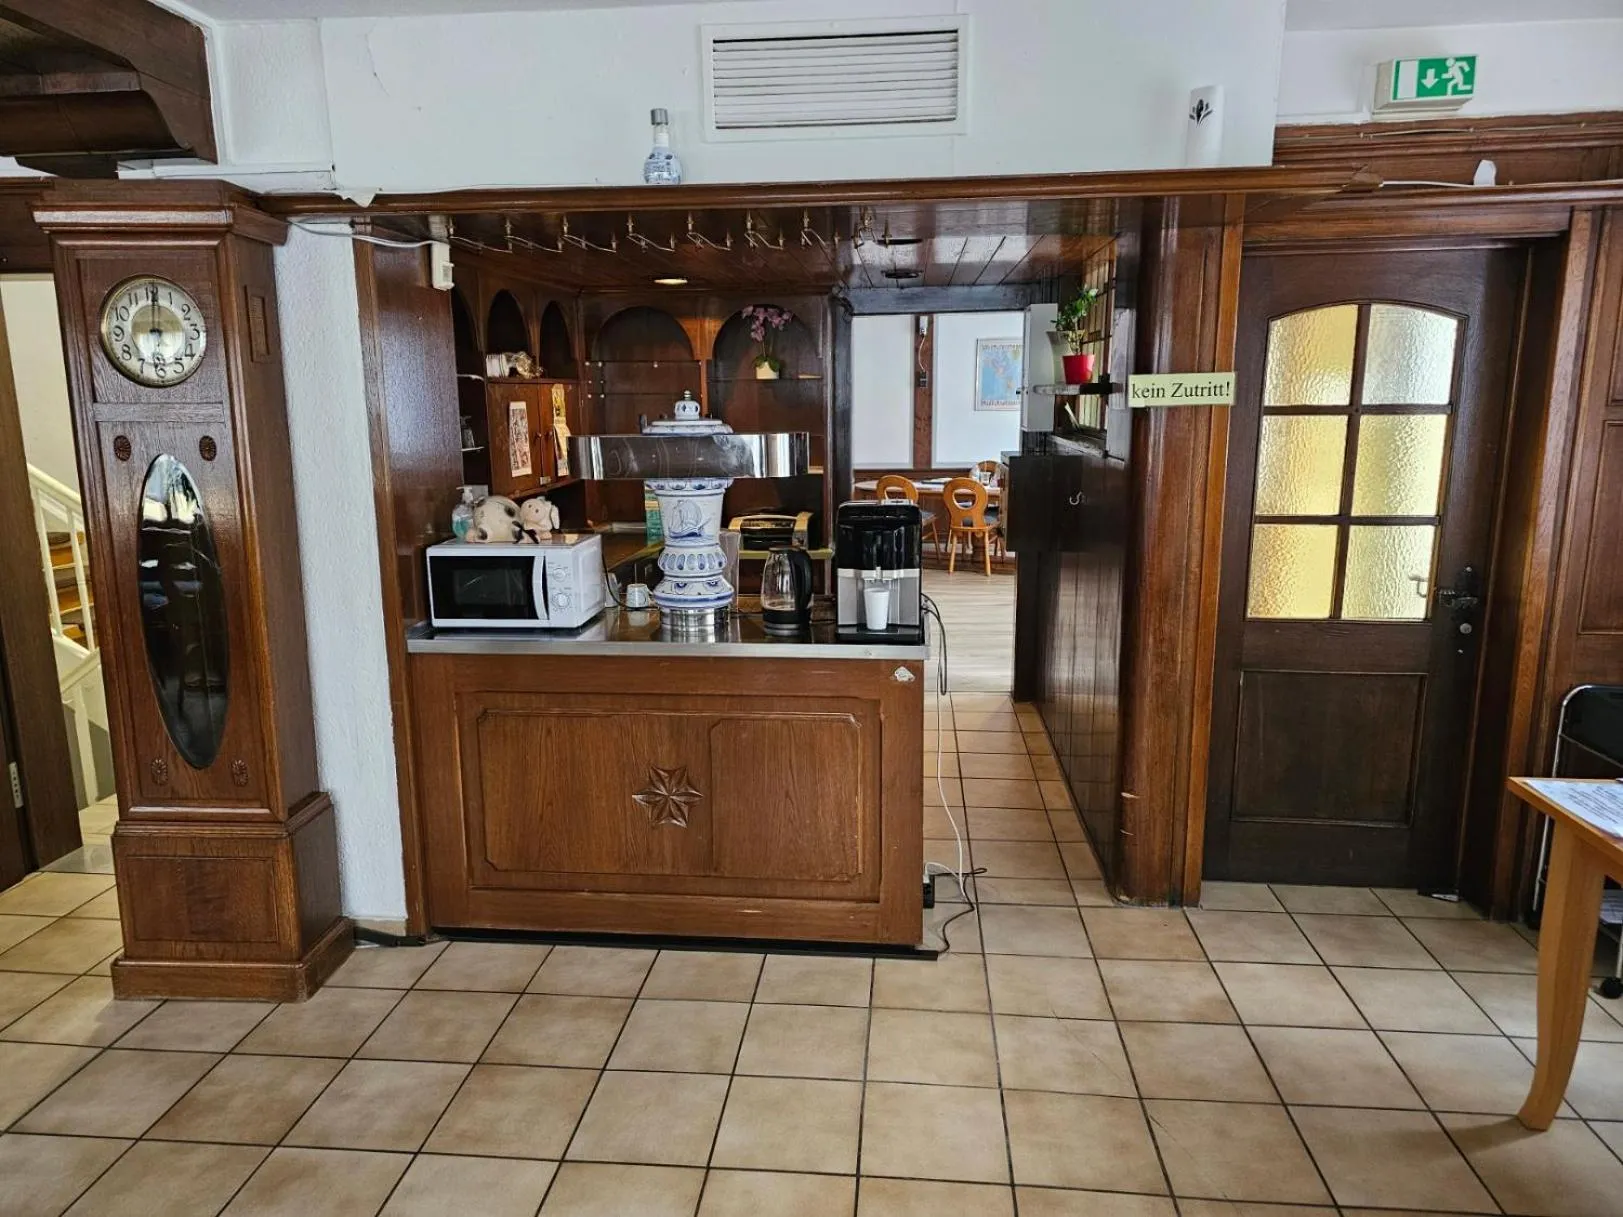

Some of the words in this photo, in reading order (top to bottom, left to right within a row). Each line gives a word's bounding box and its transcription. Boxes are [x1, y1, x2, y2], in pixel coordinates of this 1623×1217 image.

[128, 292, 139, 306] 11
[168, 291, 173, 306] 1
[115, 305, 130, 322] 10
[181, 303, 191, 321] 2
[113, 325, 125, 342] 9
[189, 323, 200, 341] 3
[121, 343, 132, 361] 8
[184, 343, 196, 360] 4
[138, 357, 146, 375] 7
[154, 361, 167, 379] 6
[173, 357, 185, 374] 5
[1132, 383, 1165, 399] kein
[1171, 381, 1230, 398] Zutritt!
